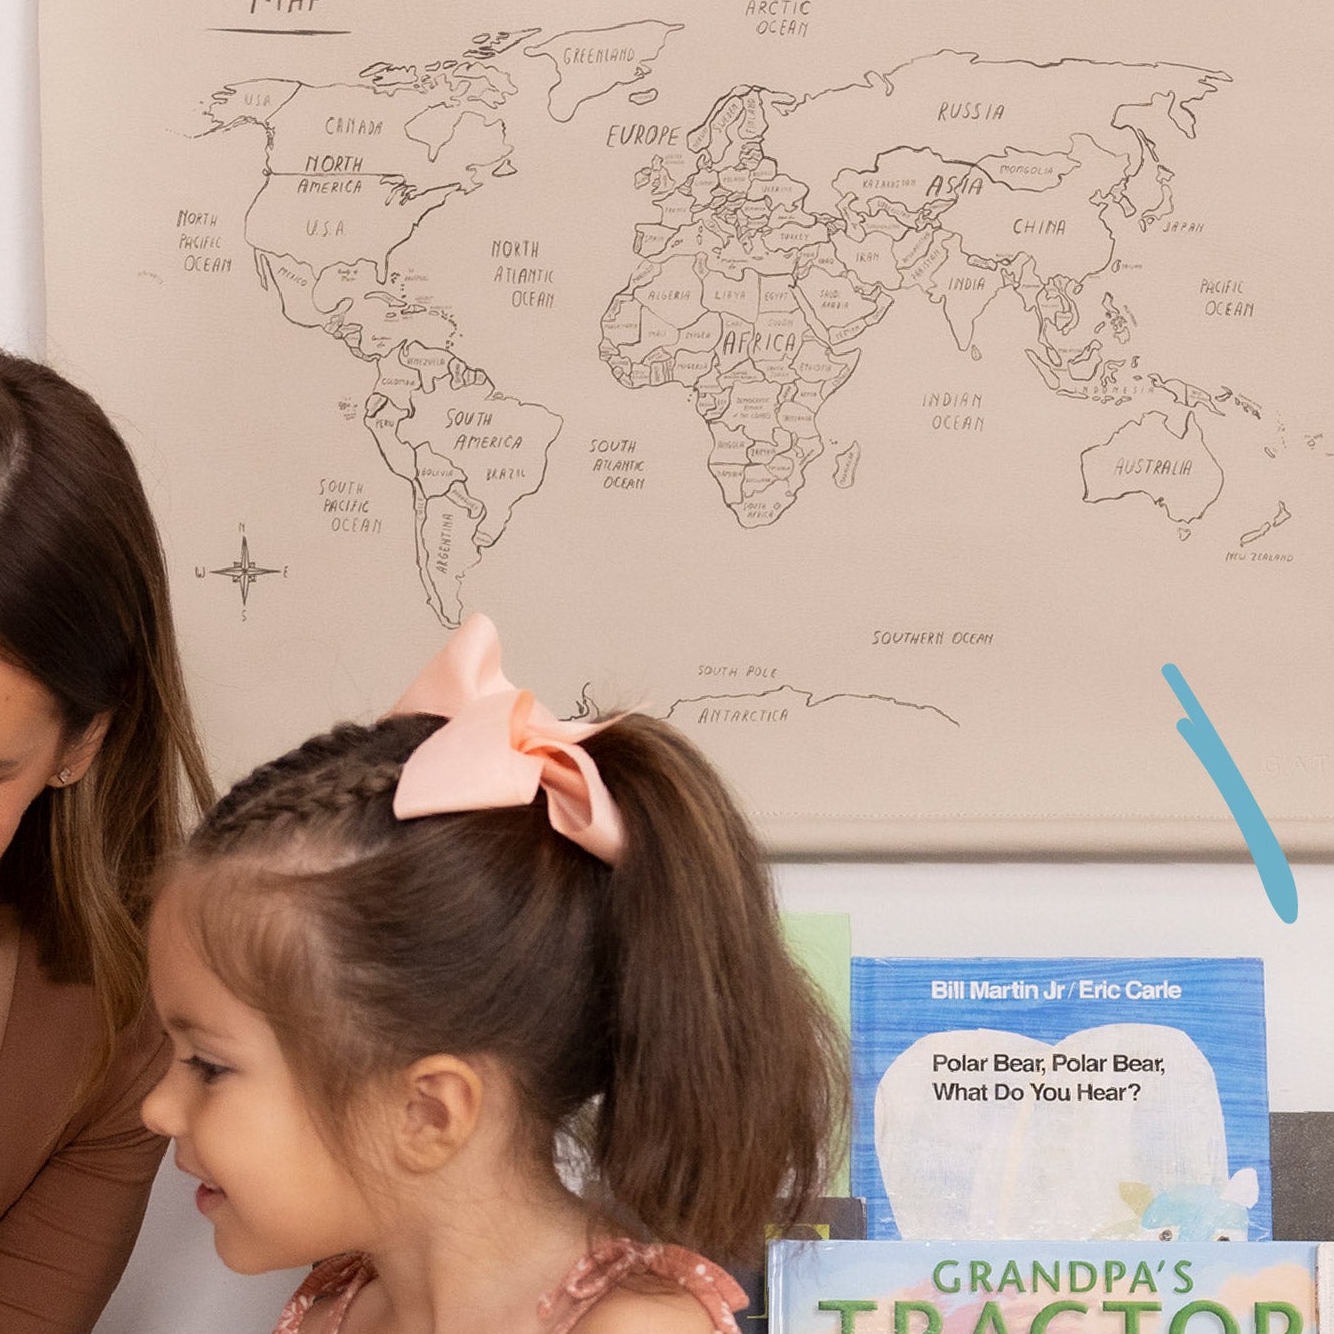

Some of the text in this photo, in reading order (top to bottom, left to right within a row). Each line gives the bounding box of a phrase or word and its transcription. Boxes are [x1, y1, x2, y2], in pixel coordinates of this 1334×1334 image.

[745, 0, 811, 17] ARCTIC
[756, 19, 809, 38] OCEAN
[563, 47, 635, 66] GREENLAND
[713, 102, 739, 134] SWEDEN
[937, 101, 1005, 122] RUSSIA
[325, 117, 383, 136] CANADA
[606, 123, 682, 148] EUROPE
[306, 155, 364, 173] NORTH
[999, 164, 1054, 177] MONGOLIA
[297, 179, 362, 194] AMERICA
[925, 175, 984, 197] ASIA
[176, 209, 218, 228] NORTH
[1012, 217, 1066, 237] CHINA
[1162, 220, 1204, 234] JAPAN
[179, 233, 222, 250] PACIFIC
[780, 233, 810, 242] TURKEY
[491, 239, 539, 259] NORTH
[855, 251, 880, 263] IRAN
[184, 255, 232, 273] OCEAN
[277, 266, 308, 288] MEXICO
[493, 265, 555, 284] ATLANTIC
[948, 277, 986, 292] INDIA
[1199, 277, 1245, 295] PACIFIC
[511, 289, 555, 308] OCEAN
[648, 290, 692, 301] ALGERIA
[714, 291, 746, 300] LIBYA
[764, 291, 789, 302] EGYPT
[1204, 299, 1255, 317] OCEAN
[722, 329, 796, 356] AFRICA
[921, 392, 983, 408] INDIAN
[375, 419, 395, 429] PERU
[445, 407, 493, 429] SOUTH
[931, 415, 985, 432] OCEAN
[453, 434, 523, 451] AMERICA
[589, 438, 637, 454] SOUTH
[420, 468, 454, 478] BOLIVIA
[485, 468, 526, 481] BRAZIL
[592, 458, 645, 473] ATLANTIC
[1114, 458, 1193, 476] AUSTRALIA
[319, 478, 364, 496] SOUTH
[602, 475, 646, 490] OCEAN
[323, 498, 370, 514] PACIFIC
[238, 522, 245, 533] N
[331, 517, 383, 535] OCEAN
[435, 513, 454, 575] ARGENTINA
[1225, 551, 1294, 563] NEW ZEALAND
[871, 630, 994, 646] SOUTHERN OCEAN
[696, 663, 779, 680] SOUTH POLE
[697, 706, 789, 725] ANTARCTICA
[931, 980, 965, 1000] Bill
[970, 980, 1039, 1000] Martin
[1043, 980, 1066, 1001] Jr
[1079, 979, 1121, 1000] Eric
[1125, 979, 1182, 1000] Carle
[932, 1053, 1166, 1077] Polar Bear, Polar Bear,
[933, 1083, 1141, 1102] What Do You Hear?
